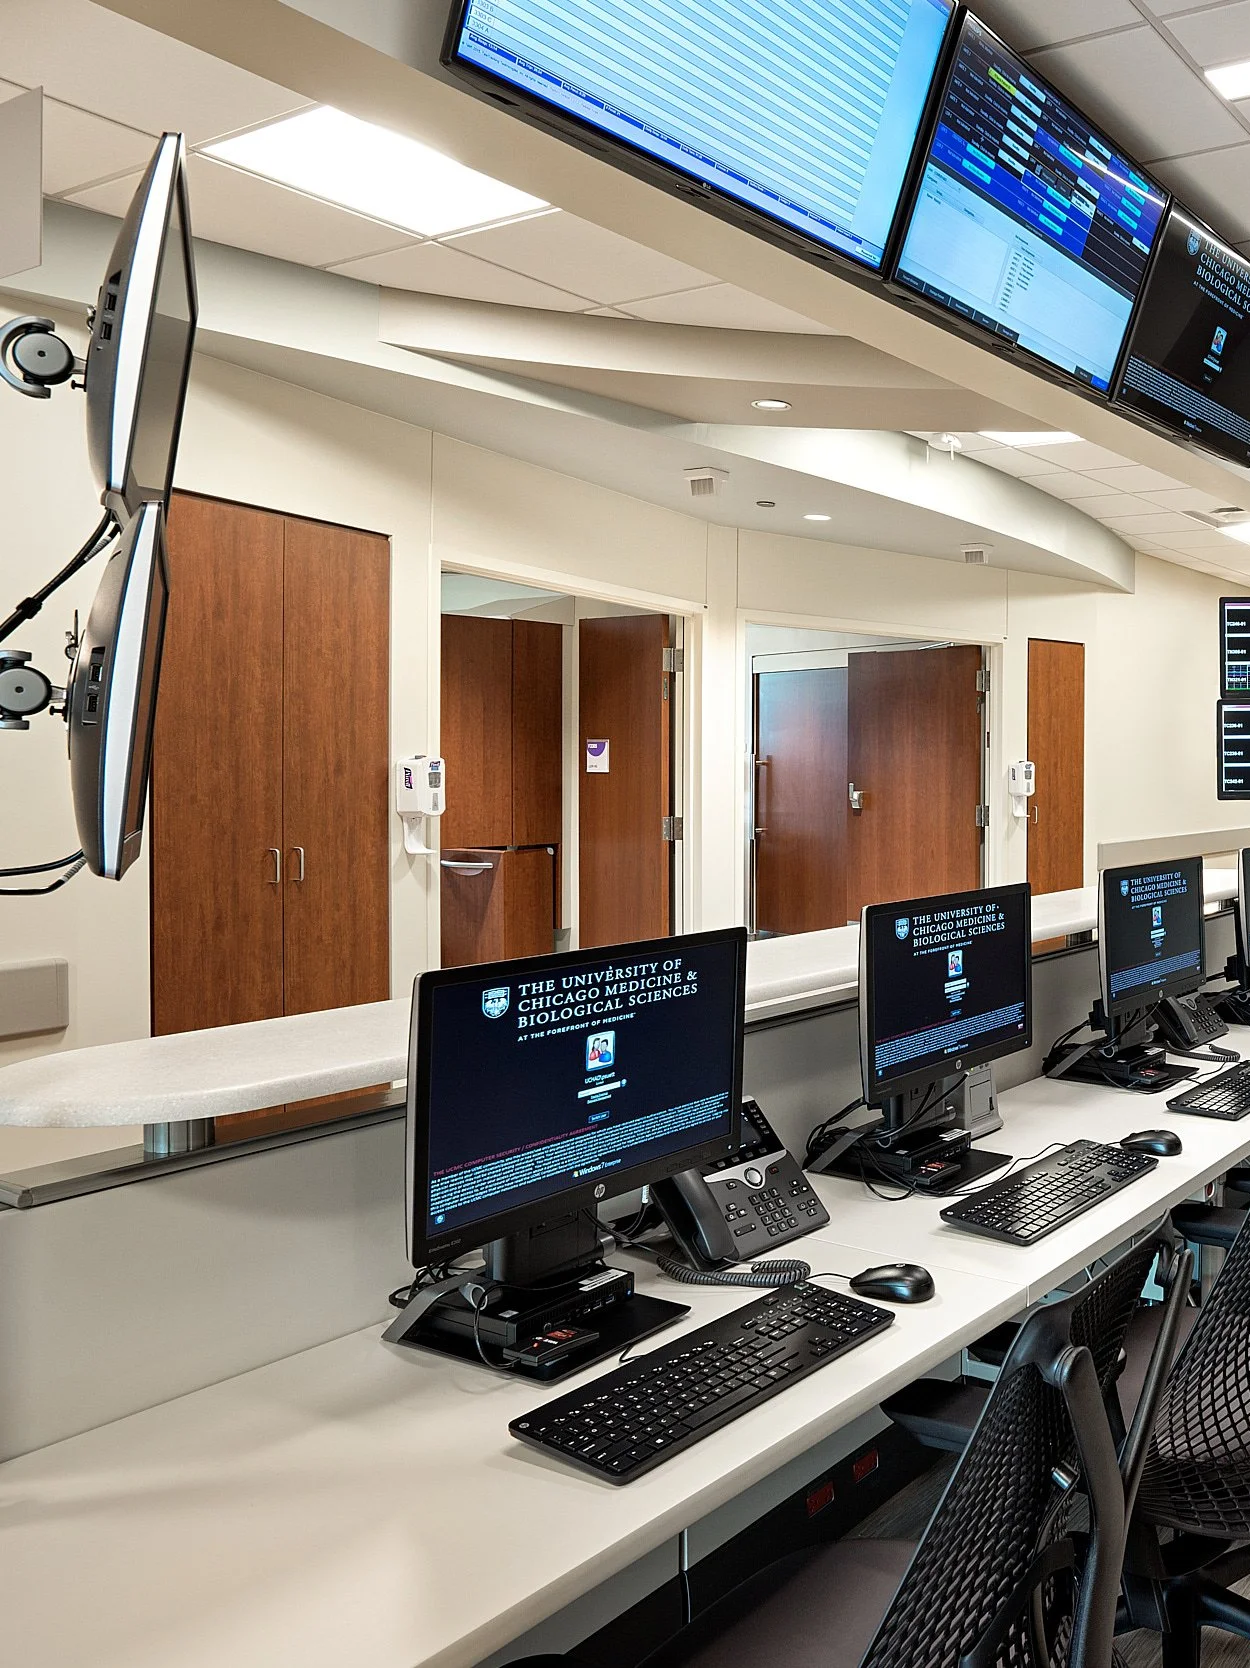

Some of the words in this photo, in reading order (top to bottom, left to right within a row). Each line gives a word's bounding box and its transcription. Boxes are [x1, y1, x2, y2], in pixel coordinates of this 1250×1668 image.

[1205, 240, 1220, 258] THE
[1200, 253, 1236, 285] CHICAGO
[1196, 266, 1241, 306] BIOLOGICAL
[1130, 878, 1142, 886] THE
[1143, 873, 1173, 883] UNIVERSITY
[1130, 884, 1155, 894] CHICAGO
[1157, 880, 1181, 890] MEDICINE
[1131, 891, 1163, 902] BIOLOGICAL
[1164, 886, 1187, 896] SCIENCES
[913, 915, 931, 925] THE
[934, 905, 983, 922] UNIVERSITY
[985, 904, 996, 912] OF
[913, 922, 954, 936] CHICAGO
[956, 914, 996, 929] MEDICINE
[913, 929, 966, 948] BIOLOGICAL
[968, 922, 1005, 936] SCIENCES
[518, 979, 555, 997] THE
[562, 962, 658, 989] UNIVERSITY
[663, 958, 682, 971] OF
[518, 987, 600, 1012] CHICAGO
[604, 972, 682, 997] MEDICINE
[687, 970, 698, 981] &
[518, 999, 623, 1028] BIOLOGICAL
[628, 983, 698, 1007] SCIENCES
[518, 1034, 528, 1042] AT
[530, 1031, 545, 1039] THE
[547, 1022, 589, 1036] FOREFRONT
[602, 1013, 635, 1024] MEDICINE
[433, 1169, 445, 1177] THE
[445, 1163, 463, 1174] UCMC
[464, 1154, 495, 1167] COMPUTER
[496, 1147, 521, 1158] SECURITY
[525, 1132, 568, 1149] CONFIDENTIALITY
[569, 1124, 598, 1136] AGREEMENT
[579, 1164, 601, 1175] Windows
